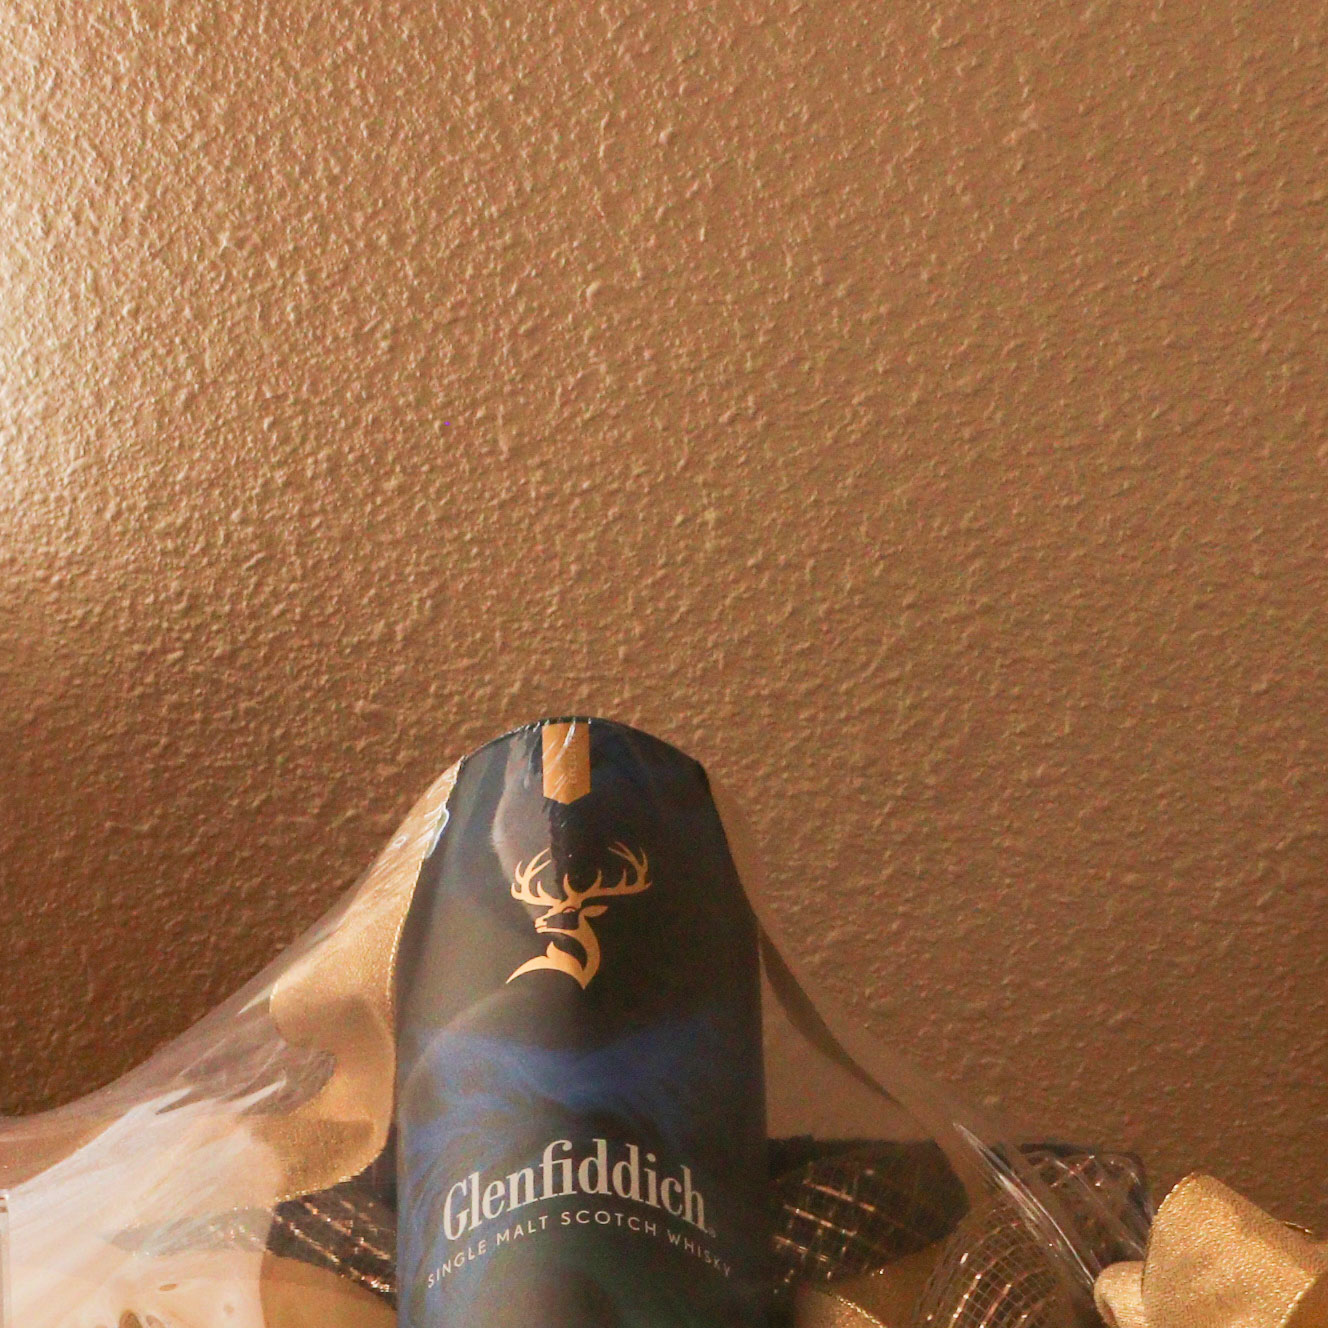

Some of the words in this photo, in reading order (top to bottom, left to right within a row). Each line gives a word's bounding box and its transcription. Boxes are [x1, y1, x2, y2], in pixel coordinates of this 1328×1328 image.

[443, 1137, 710, 1241] Glenfiddich
[426, 1239, 489, 1289] SINGLE
[495, 1215, 549, 1250] MALT
[560, 1209, 659, 1237] SCOTCH
[665, 1231, 733, 1278] WHISKY
